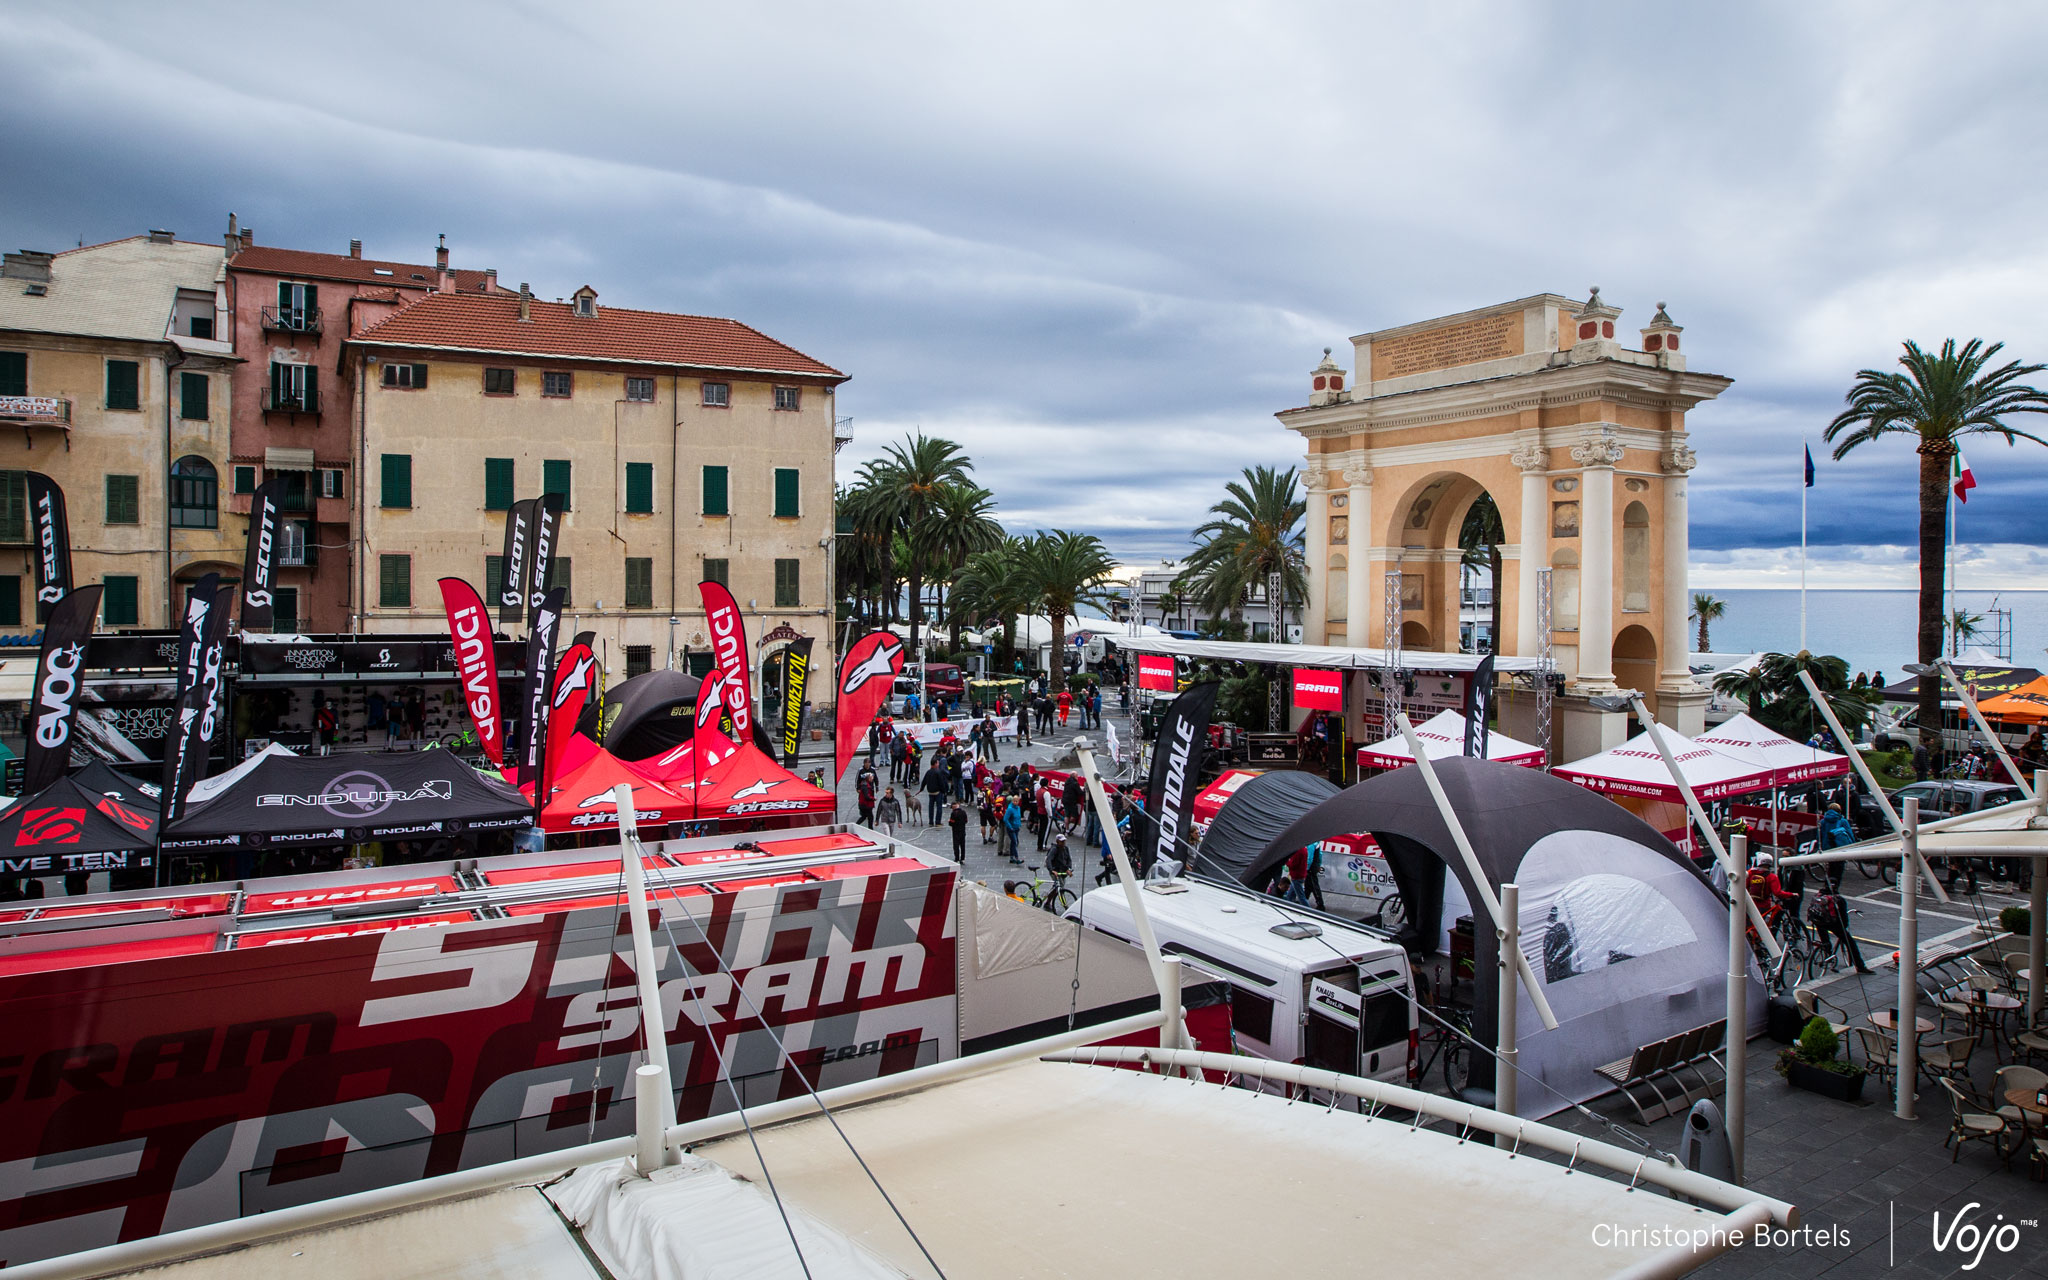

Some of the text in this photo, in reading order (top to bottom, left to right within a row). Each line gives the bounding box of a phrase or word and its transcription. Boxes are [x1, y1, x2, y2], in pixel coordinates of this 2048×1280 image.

[255, 496, 276, 588] SCOTT
[508, 513, 526, 590] SCOTT
[535, 507, 552, 590] SCOTT
[1140, 667, 1172, 677] SRAM
[36, 641, 86, 749] evoc
[528, 625, 553, 766] ENDURA
[1295, 682, 1340, 694] SRAM
[1694, 737, 1752, 748] SRAM
[1757, 738, 1792, 748] SRAM
[1673, 749, 1713, 763] SRAM
[256, 786, 446, 807] ENDURA
[1609, 781, 1663, 796] WWW.SRAM.COM
[725, 799, 810, 815] alpinestars
[161, 818, 528, 849] ENDURA ENDURA ENDURA ENDURA
[0, 850, 128, 872] IVE TEN
[1361, 868, 1395, 884] Finale
[557, 942, 926, 1050] SRAM
[1315, 985, 1336, 999] KNAUS
[816, 1033, 911, 1064] SRAM
